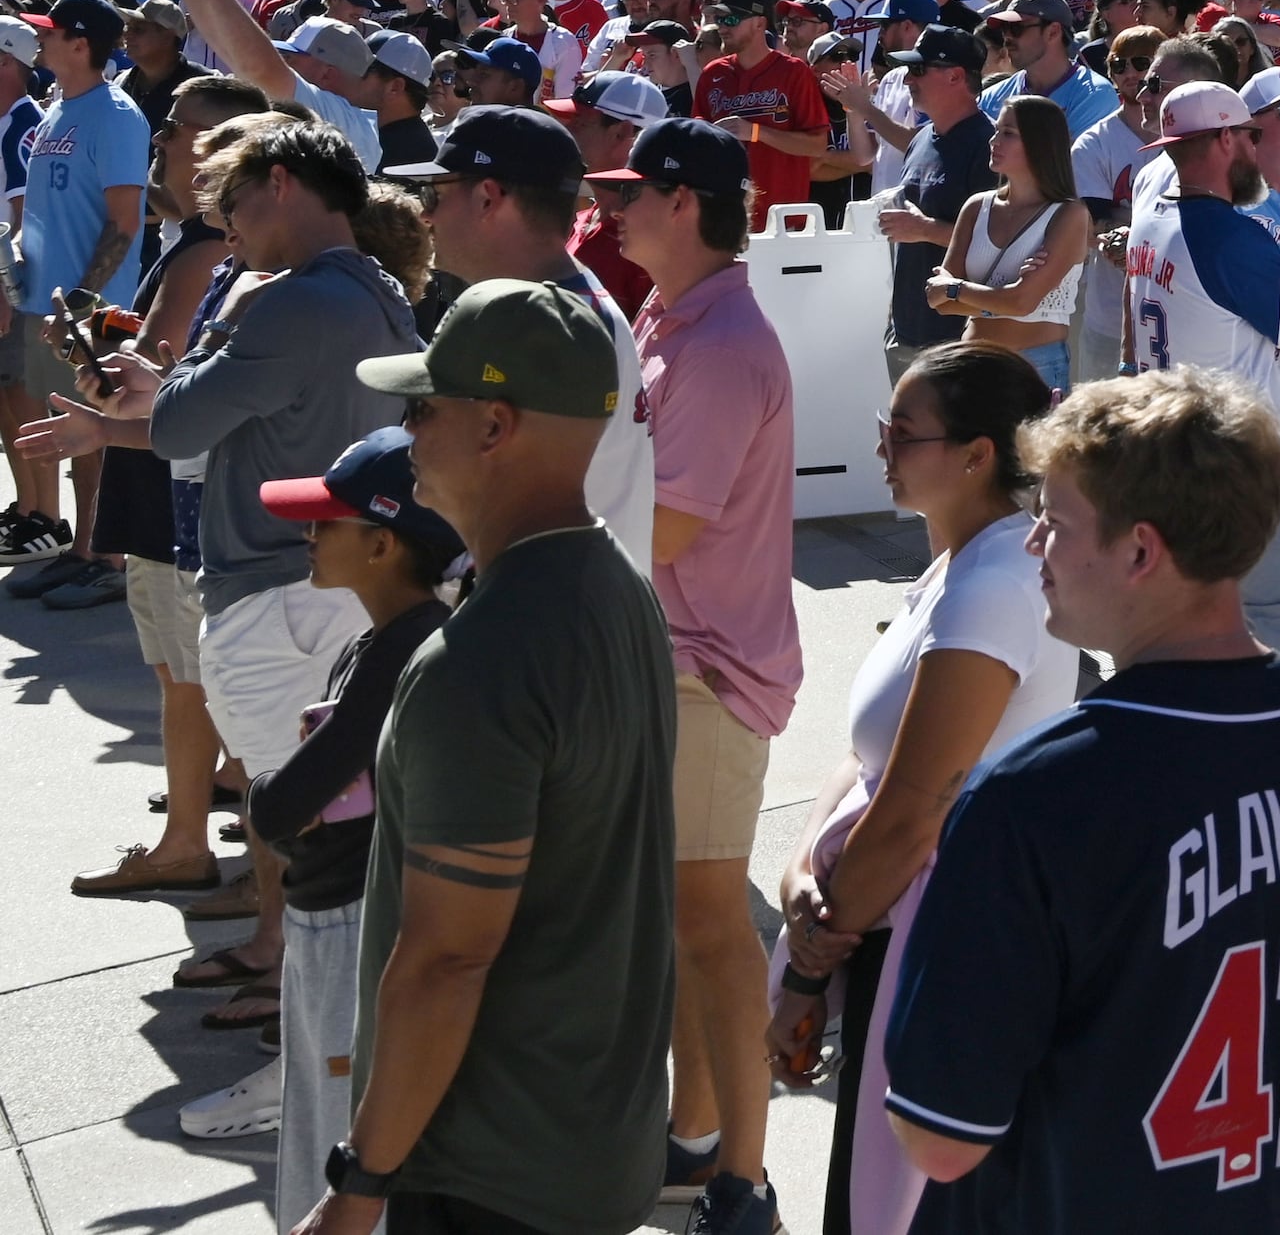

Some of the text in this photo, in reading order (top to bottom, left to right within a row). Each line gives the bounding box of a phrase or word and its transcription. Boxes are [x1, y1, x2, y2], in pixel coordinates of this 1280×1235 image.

[709, 87, 779, 118] Braves
[50, 160, 70, 192] 13
[1154, 257, 1175, 295] JR.
